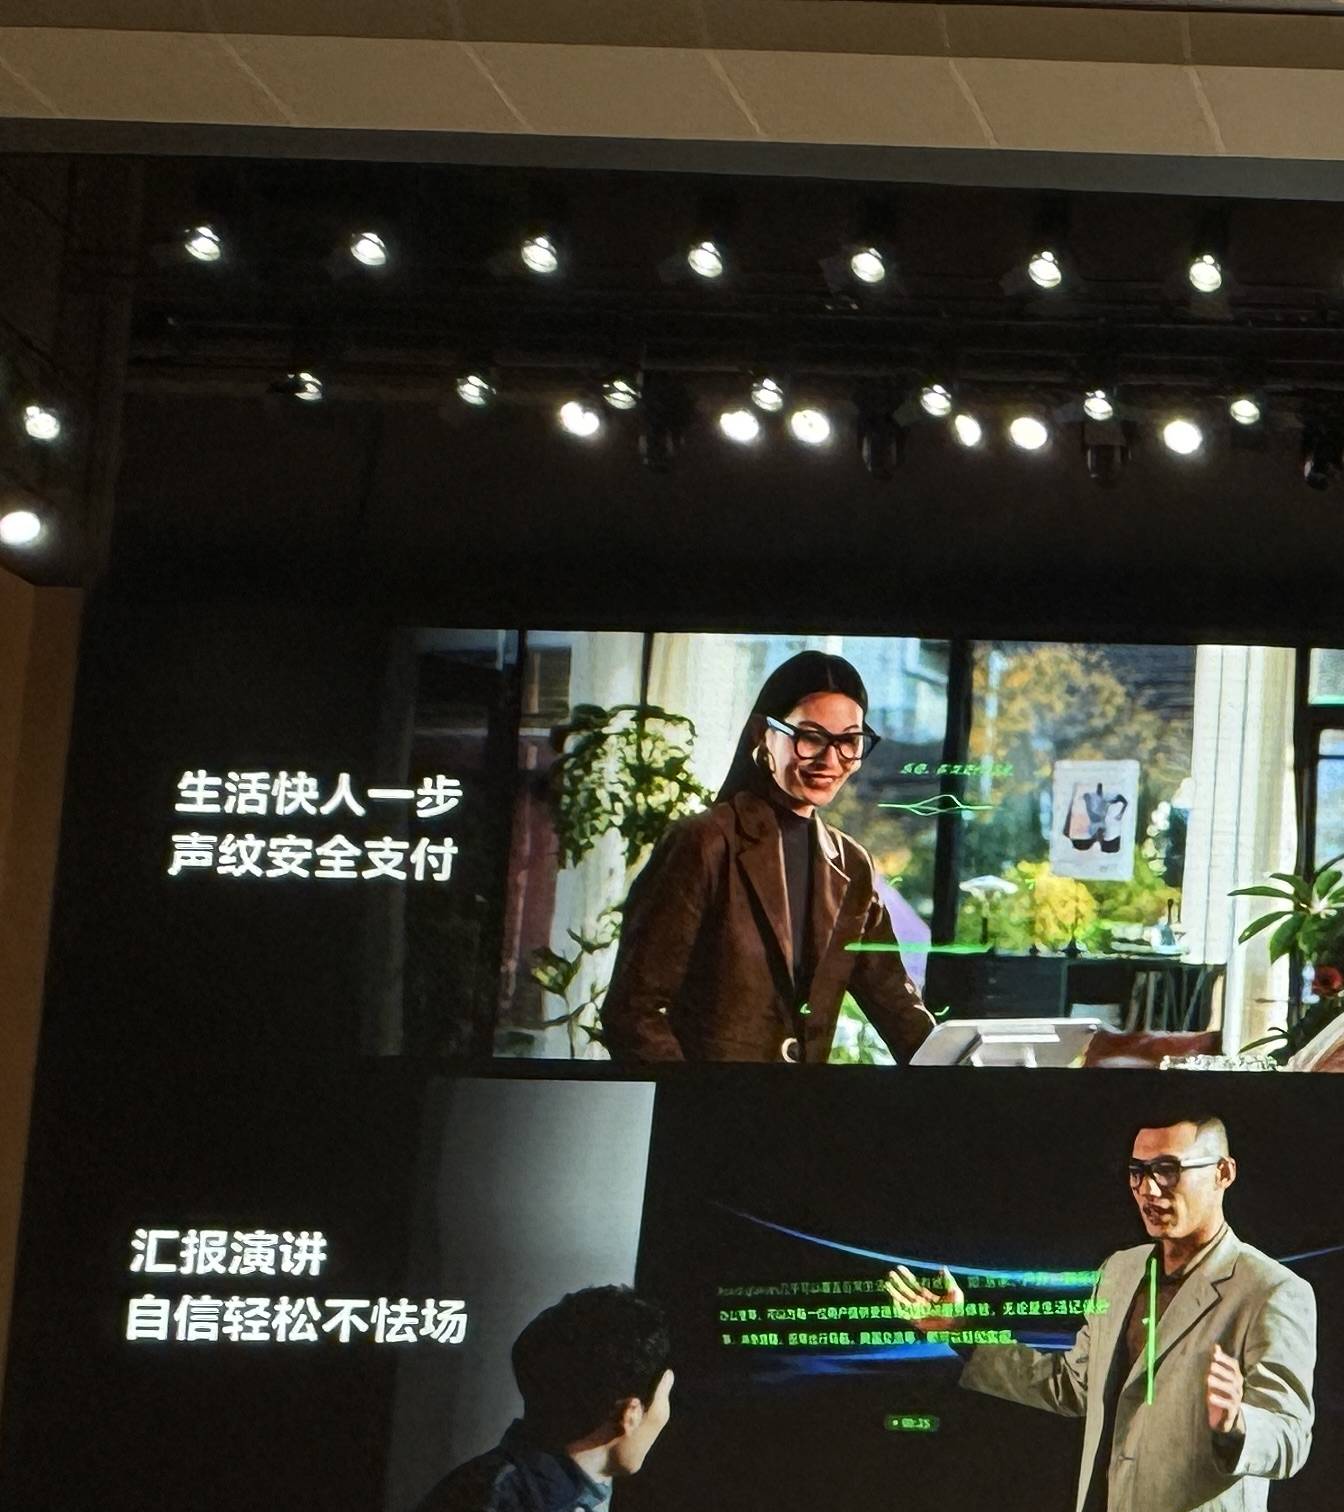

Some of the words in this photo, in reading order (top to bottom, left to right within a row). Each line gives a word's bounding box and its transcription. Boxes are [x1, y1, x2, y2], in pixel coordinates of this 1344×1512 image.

[175, 770, 463, 817] 生活快人一步
[168, 832, 458, 881] 声纹安全支付
[130, 1229, 327, 1276] 汇报演讲
[126, 1294, 467, 1343] 自信轻松不怯场
